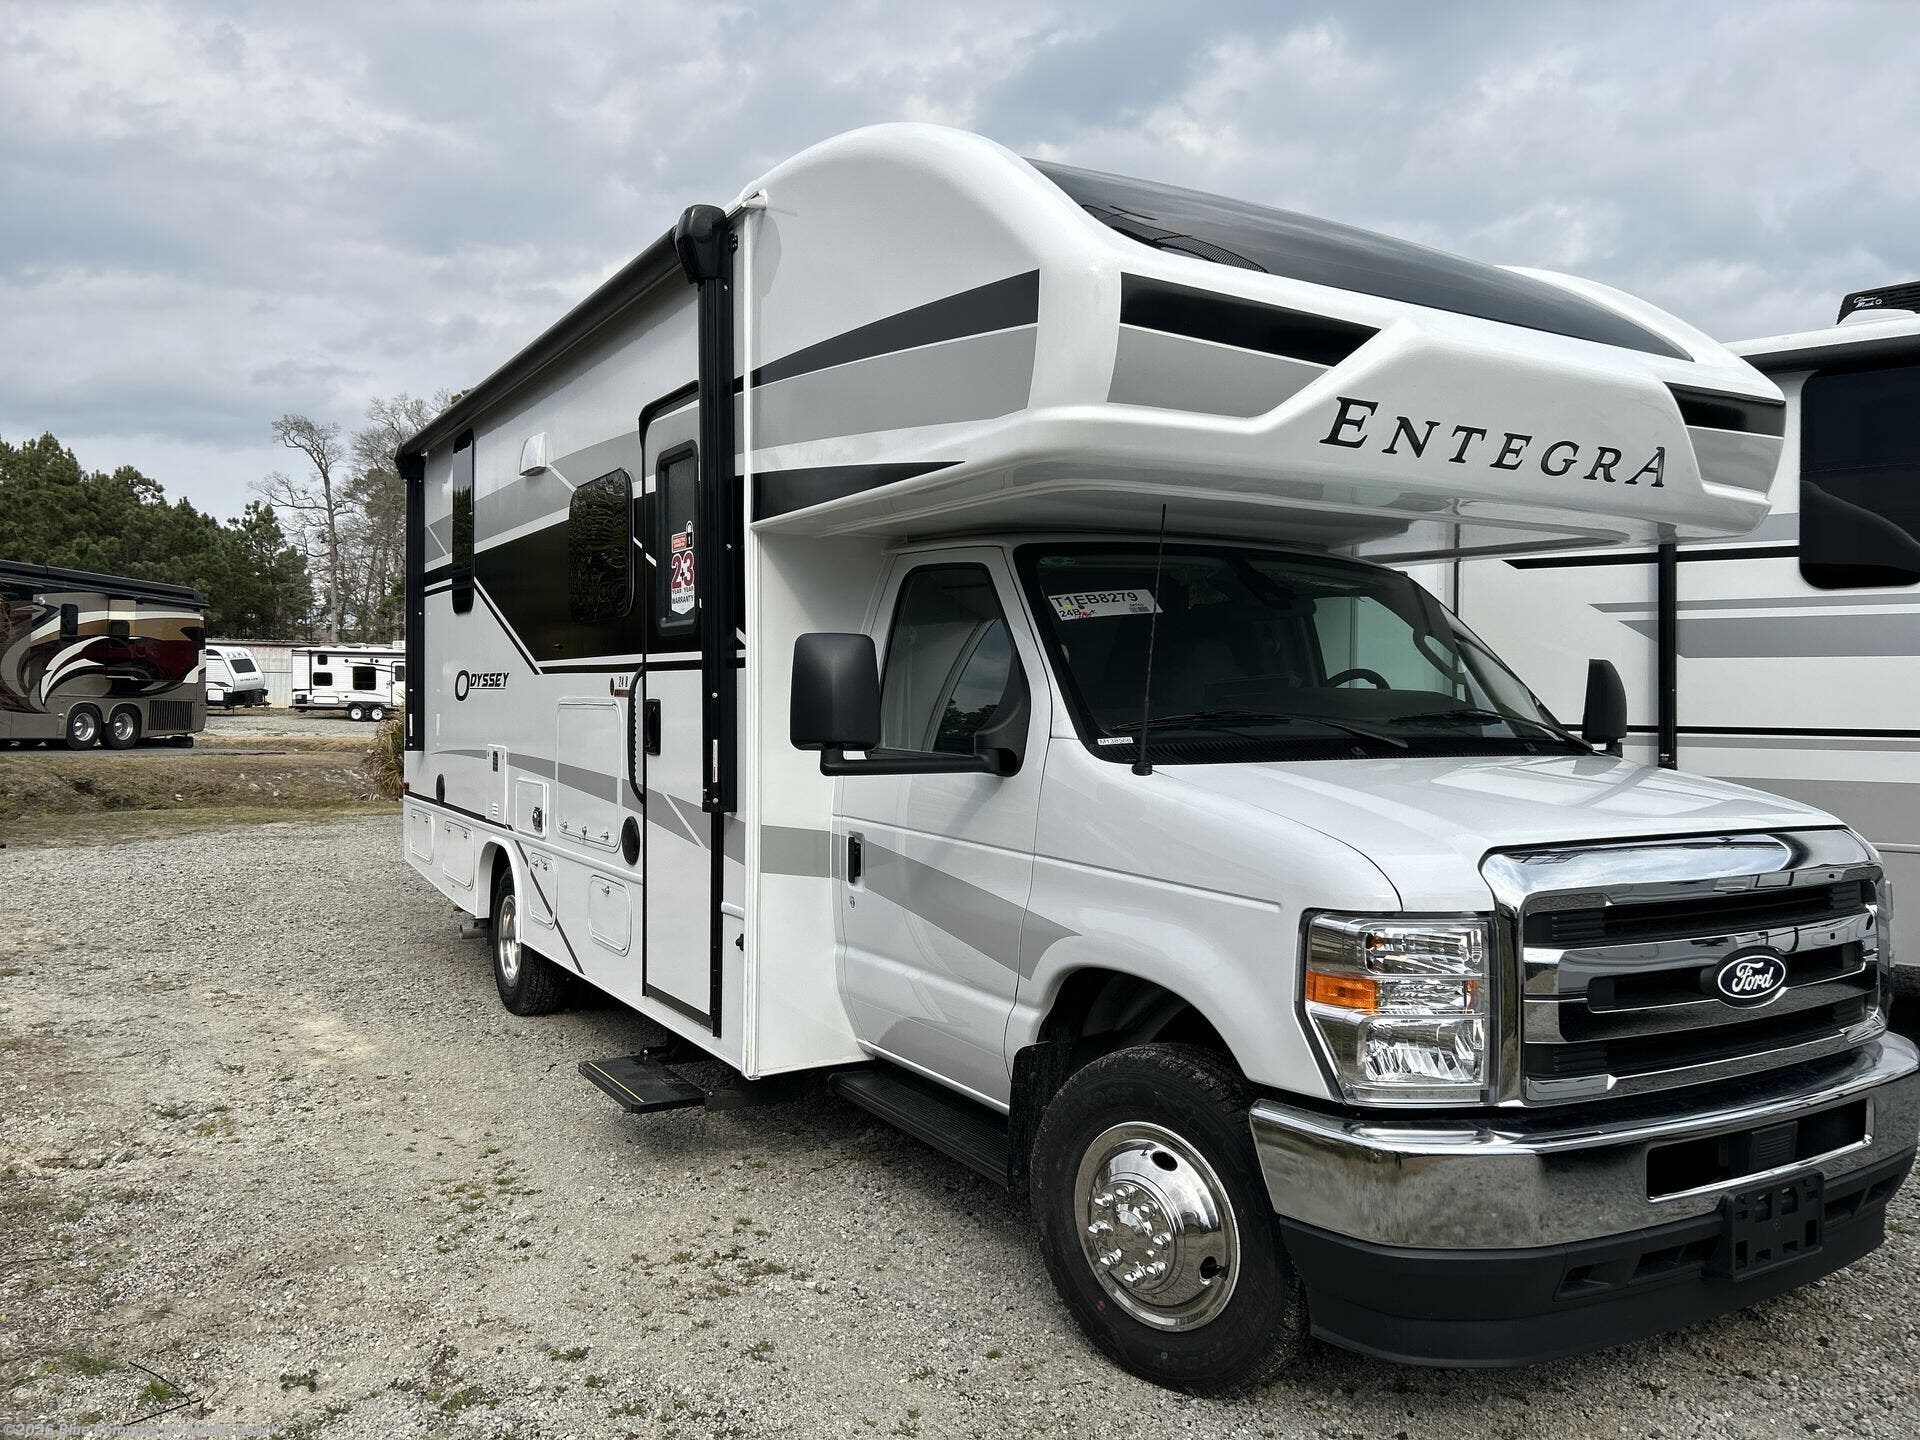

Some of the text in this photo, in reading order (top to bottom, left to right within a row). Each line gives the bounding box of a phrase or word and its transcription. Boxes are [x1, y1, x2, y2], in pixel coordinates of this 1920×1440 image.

[1319, 396, 1666, 488] ENTEGRA
[672, 595, 694, 605] WARRANTY
[1050, 592, 1138, 607] T1EB8279
[455, 670, 510, 701] ODYSSEY
[1732, 962, 1774, 992] Ford
